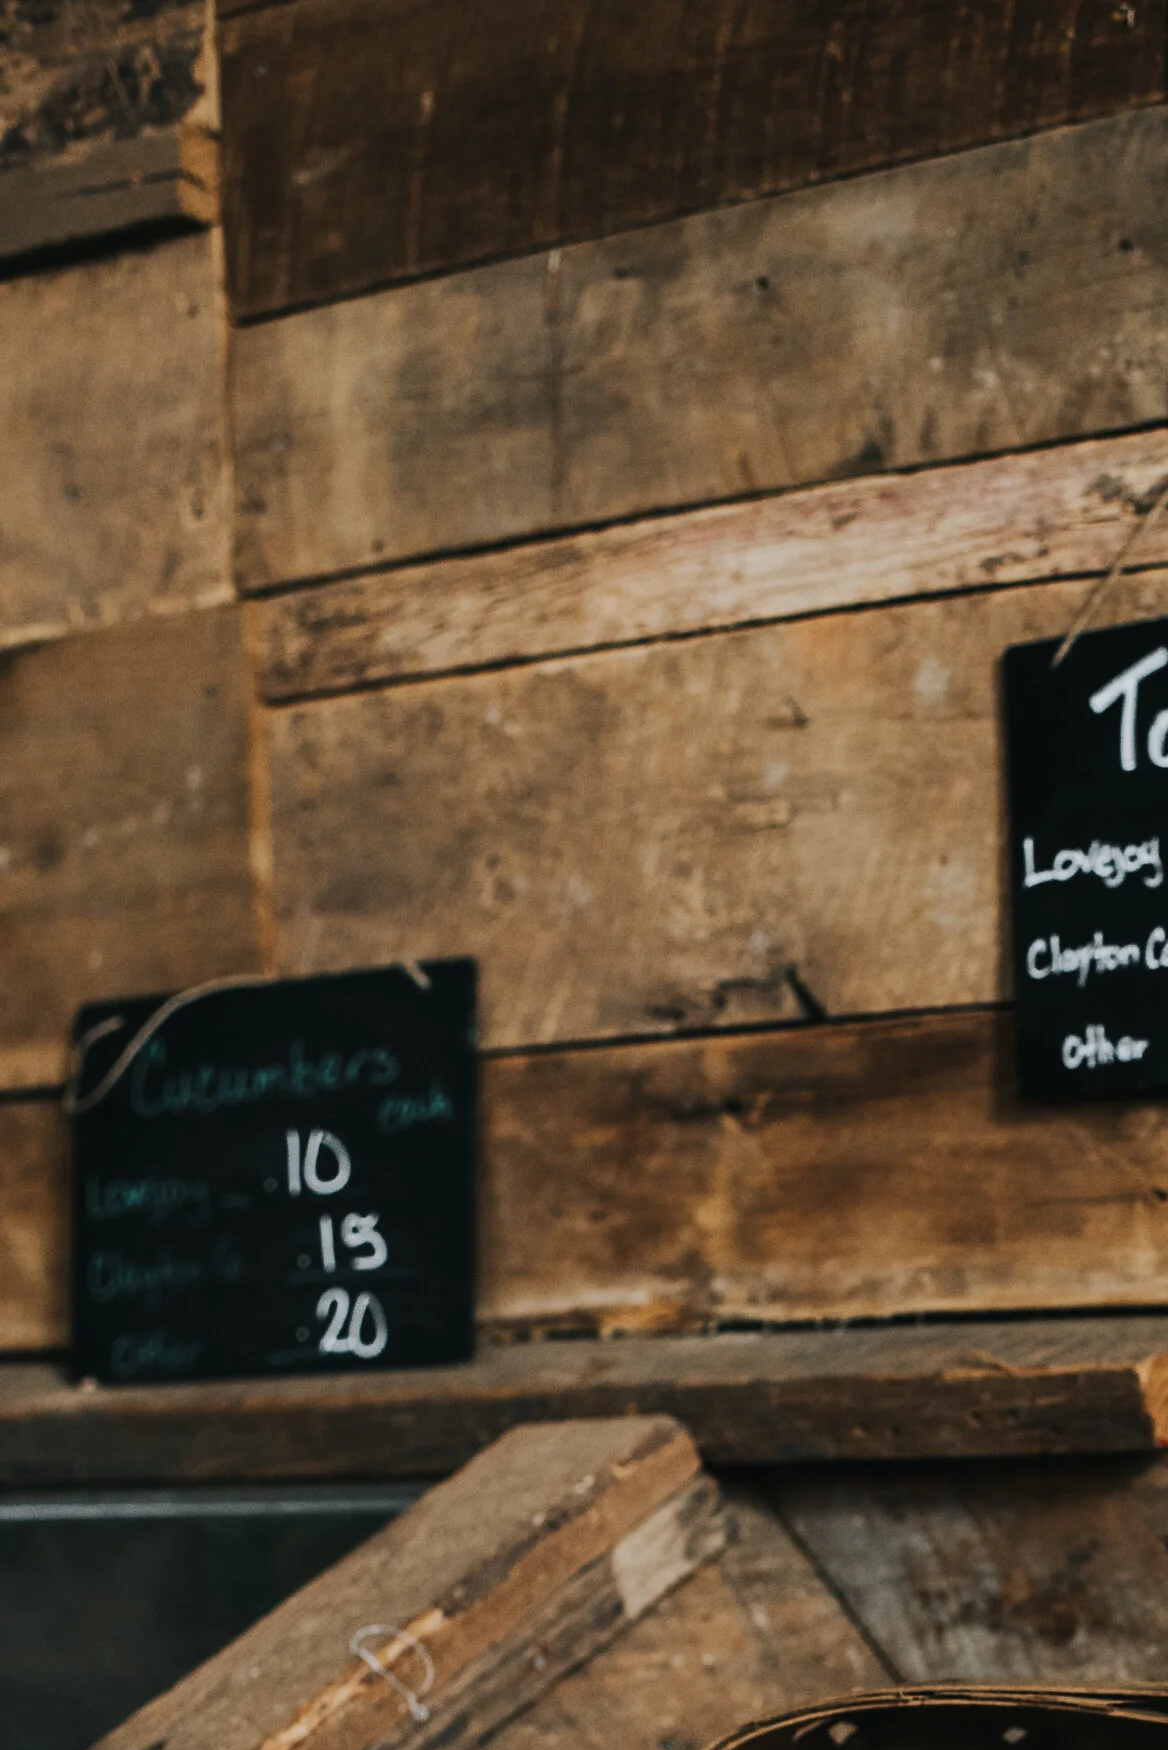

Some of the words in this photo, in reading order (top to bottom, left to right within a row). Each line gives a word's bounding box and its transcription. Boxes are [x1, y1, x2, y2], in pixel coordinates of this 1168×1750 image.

[1023, 835, 1164, 889] Lovejoy
[1026, 933, 1141, 989] Clayton
[129, 1035, 400, 1119] Cucumbers
